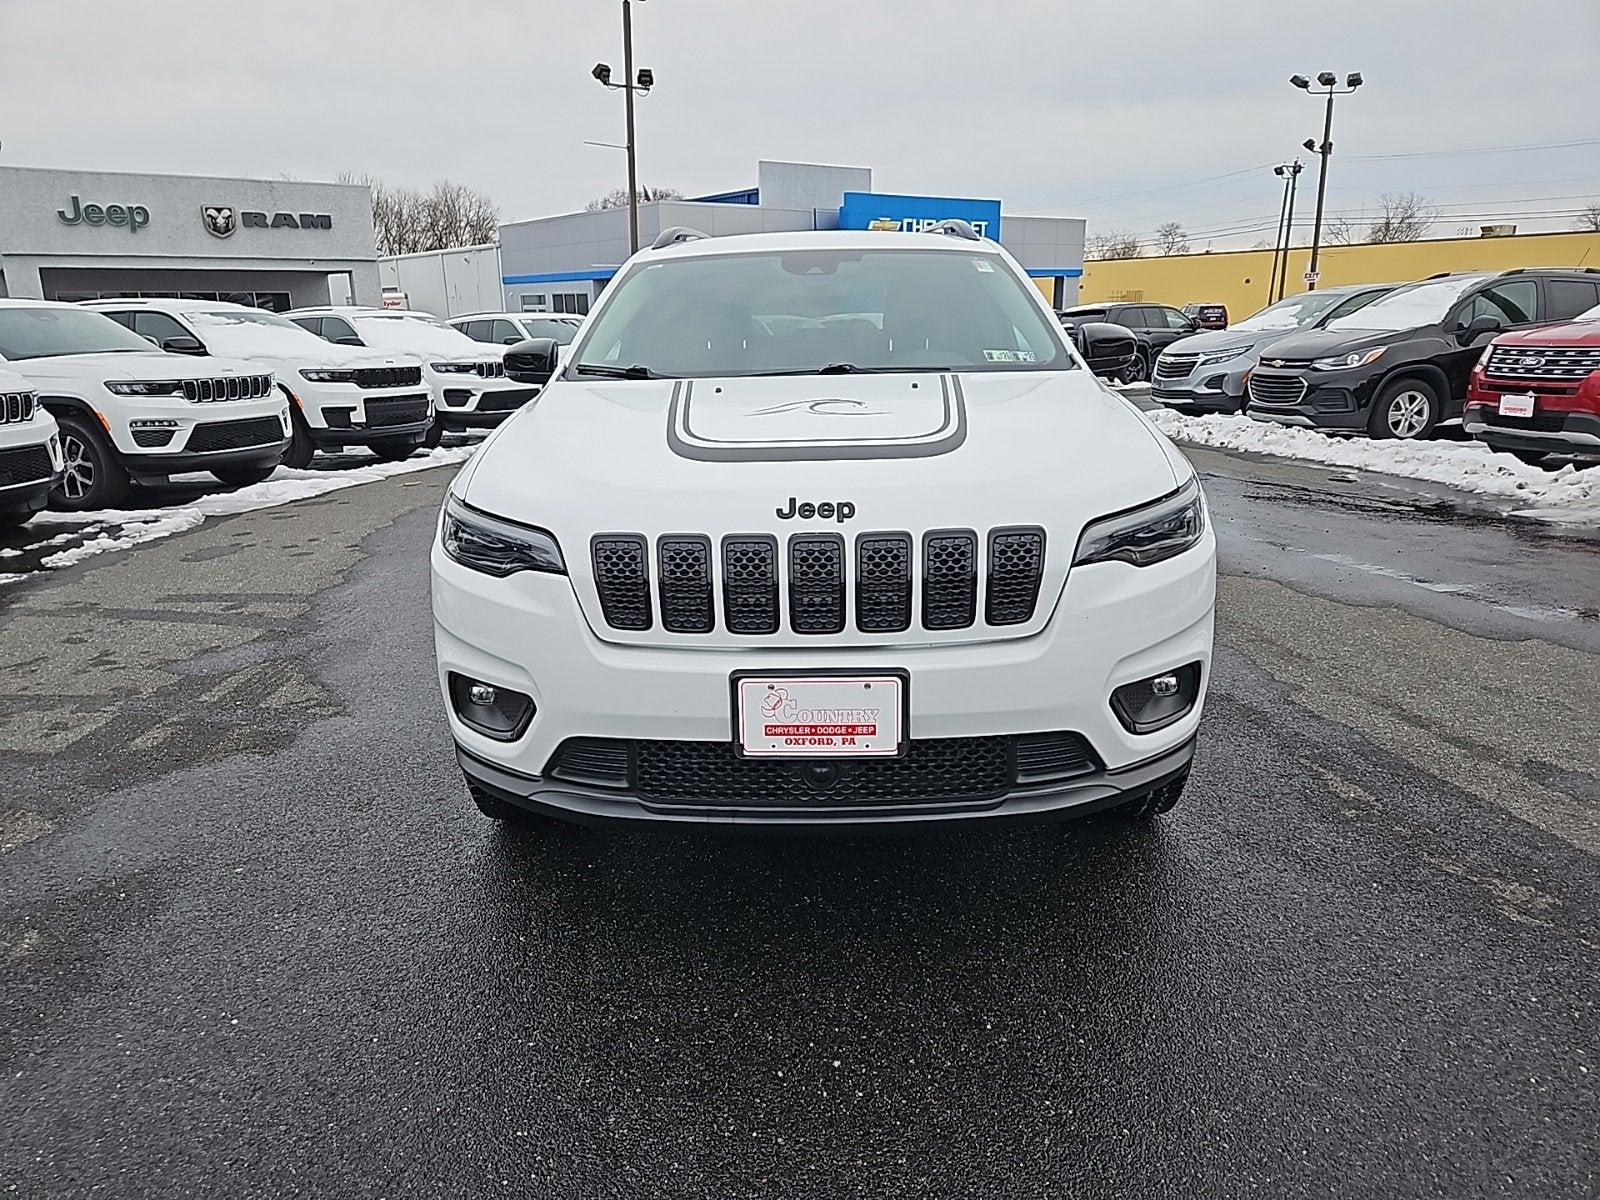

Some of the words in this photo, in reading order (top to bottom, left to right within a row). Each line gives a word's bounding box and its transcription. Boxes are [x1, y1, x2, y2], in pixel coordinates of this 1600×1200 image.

[57, 196, 150, 232] Jeep
[241, 211, 332, 230] RAM
[775, 497, 856, 523] Jeep
[766, 726, 811, 735] CHRYSLER
[816, 726, 848, 735] DODGE
[852, 726, 875, 735] JEEP
[784, 737, 837, 747] OXFORD,
[841, 737, 857, 746] PA
